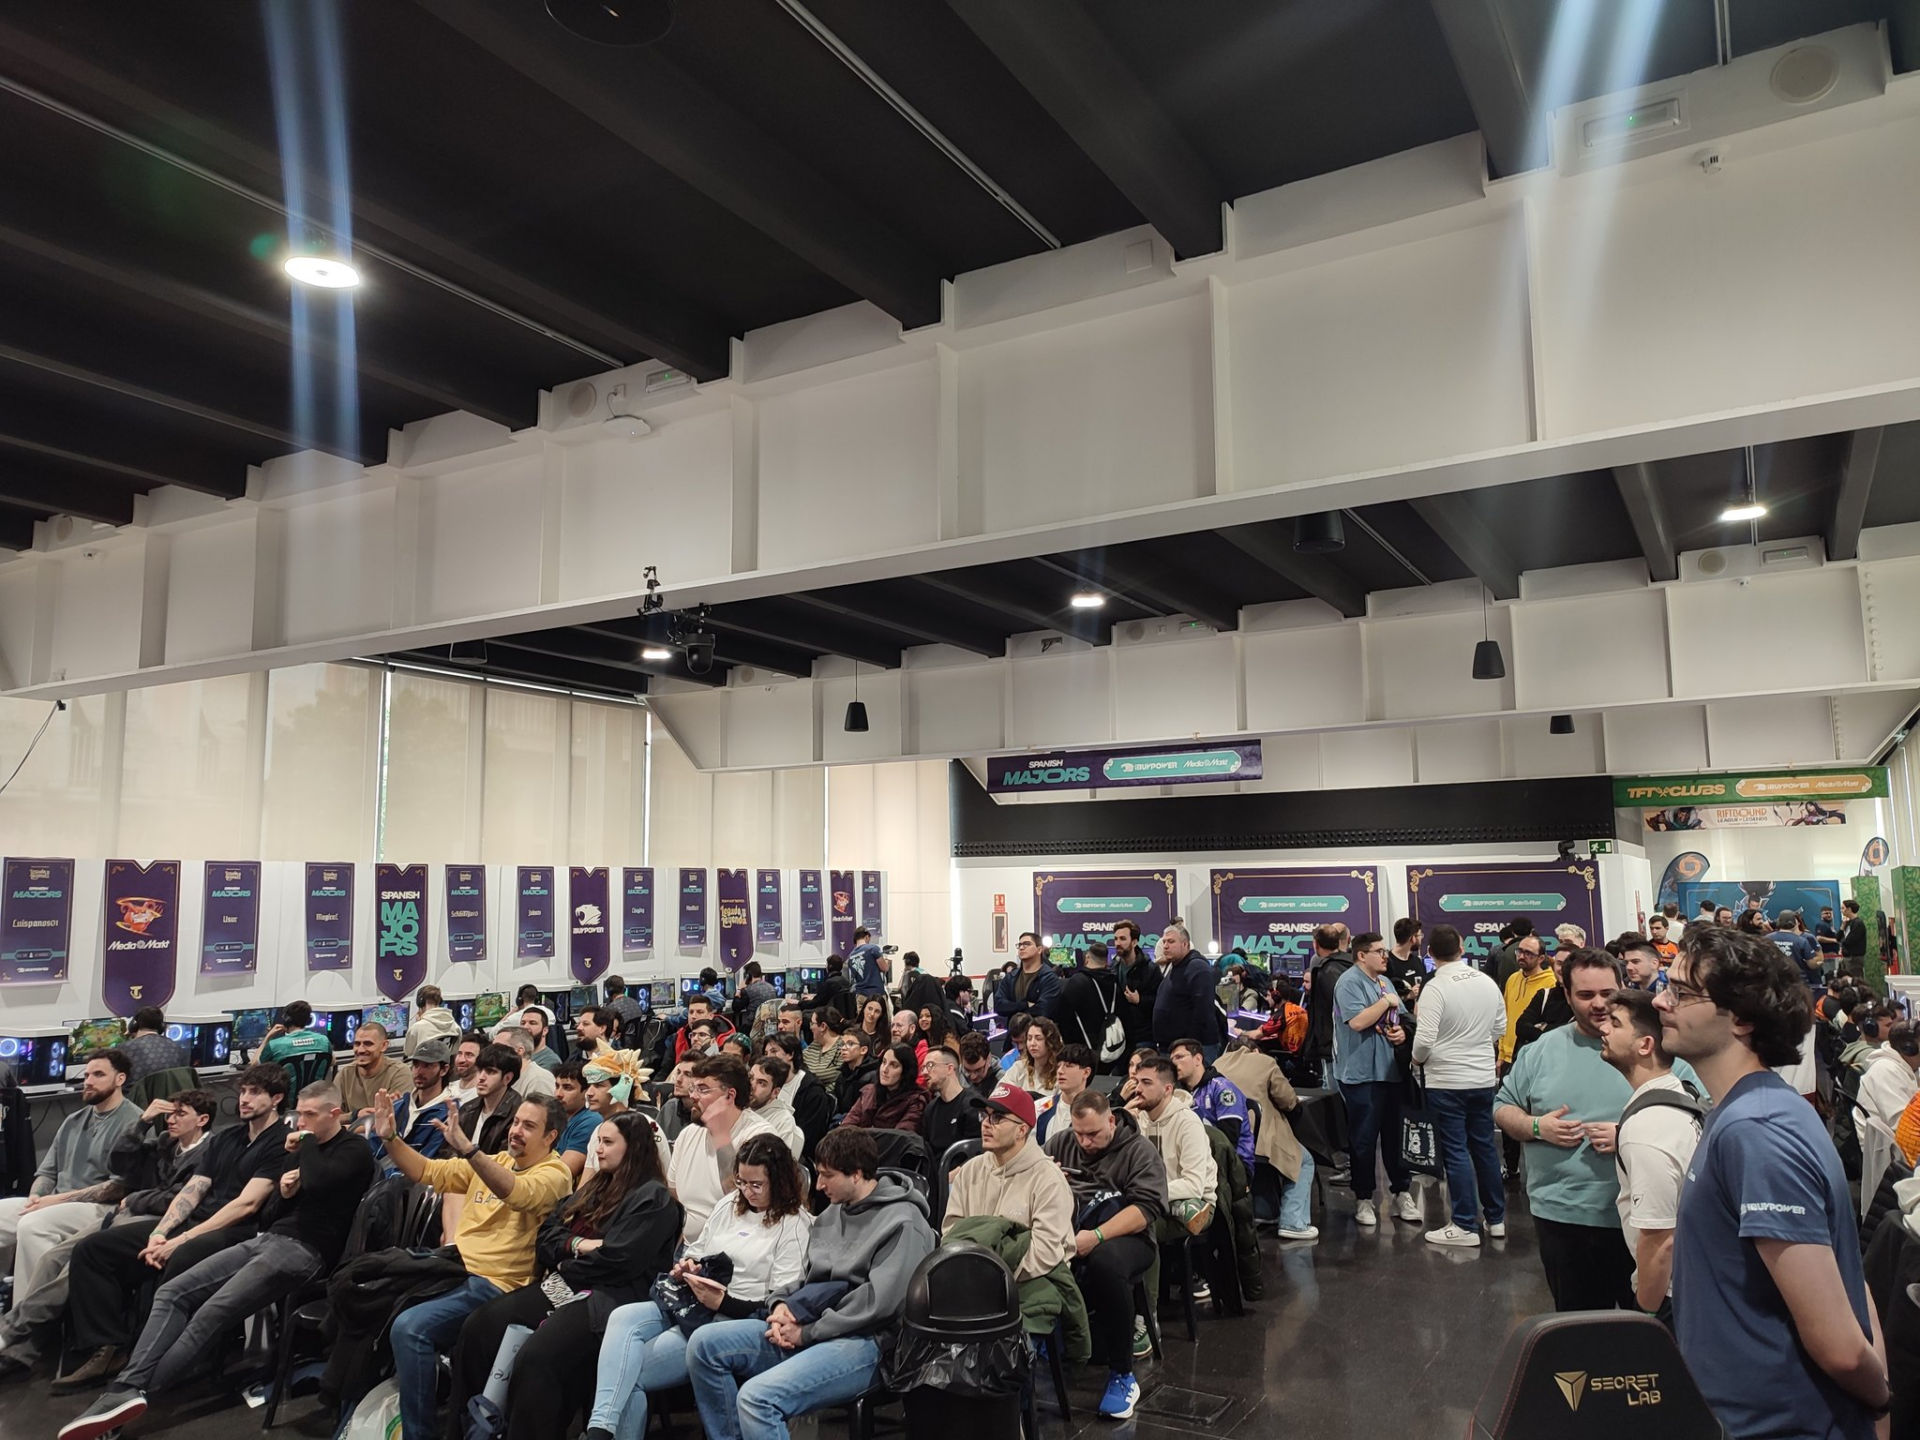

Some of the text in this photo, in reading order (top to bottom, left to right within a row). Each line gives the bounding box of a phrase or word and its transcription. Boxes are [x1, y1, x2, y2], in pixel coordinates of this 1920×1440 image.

[1028, 759, 1064, 769] SPANISH
[1003, 766, 1091, 786] MAJORS
[1667, 784, 1726, 797] CLUBS
[1716, 807, 1767, 818] RIFTBOUND
[13, 890, 62, 899] MAJORS
[211, 890, 251, 898] MAJORS
[381, 890, 420, 900] SPANISH
[1590, 1373, 1660, 1391] SECRET
[1627, 1390, 1662, 1406] LAB
